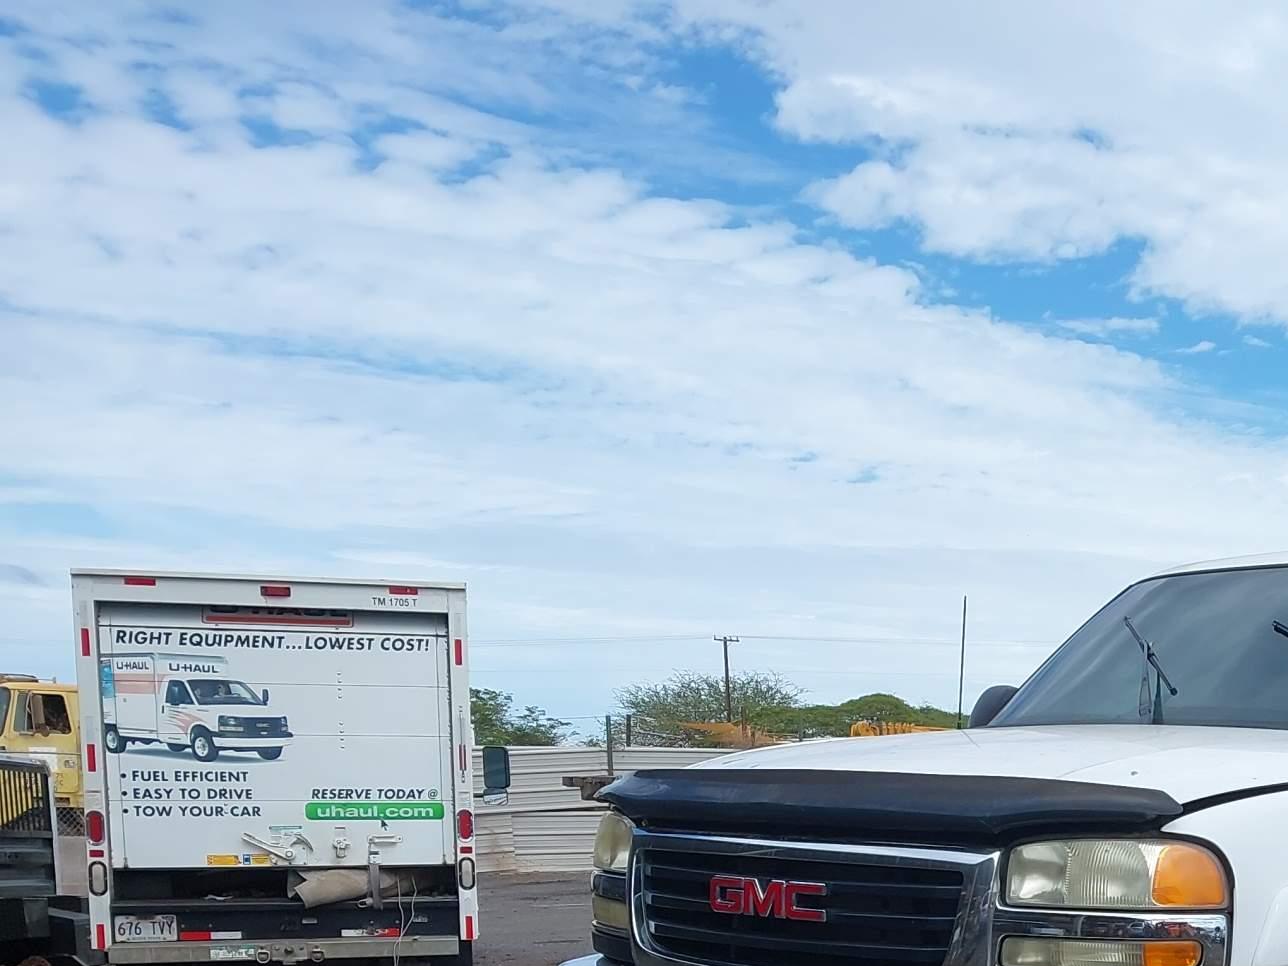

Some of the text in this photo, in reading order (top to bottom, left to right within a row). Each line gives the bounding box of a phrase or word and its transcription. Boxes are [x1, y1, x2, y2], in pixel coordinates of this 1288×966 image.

[372, 597, 418, 607] TM 1705 T
[115, 629, 173, 646] RIGHT
[380, 637, 430, 652] COST!
[168, 662, 220, 674] U-HAUL
[131, 770, 249, 782] FUEL EFFICIENT
[132, 787, 253, 800] EASY TO DRIVE
[311, 788, 372, 800] RESERVE
[376, 788, 425, 800] TODAY
[133, 805, 262, 817] TOW YOUR CAR
[316, 805, 434, 818] uhaul.com
[709, 874, 827, 922] GMC
[117, 920, 175, 937] 676 TVY
